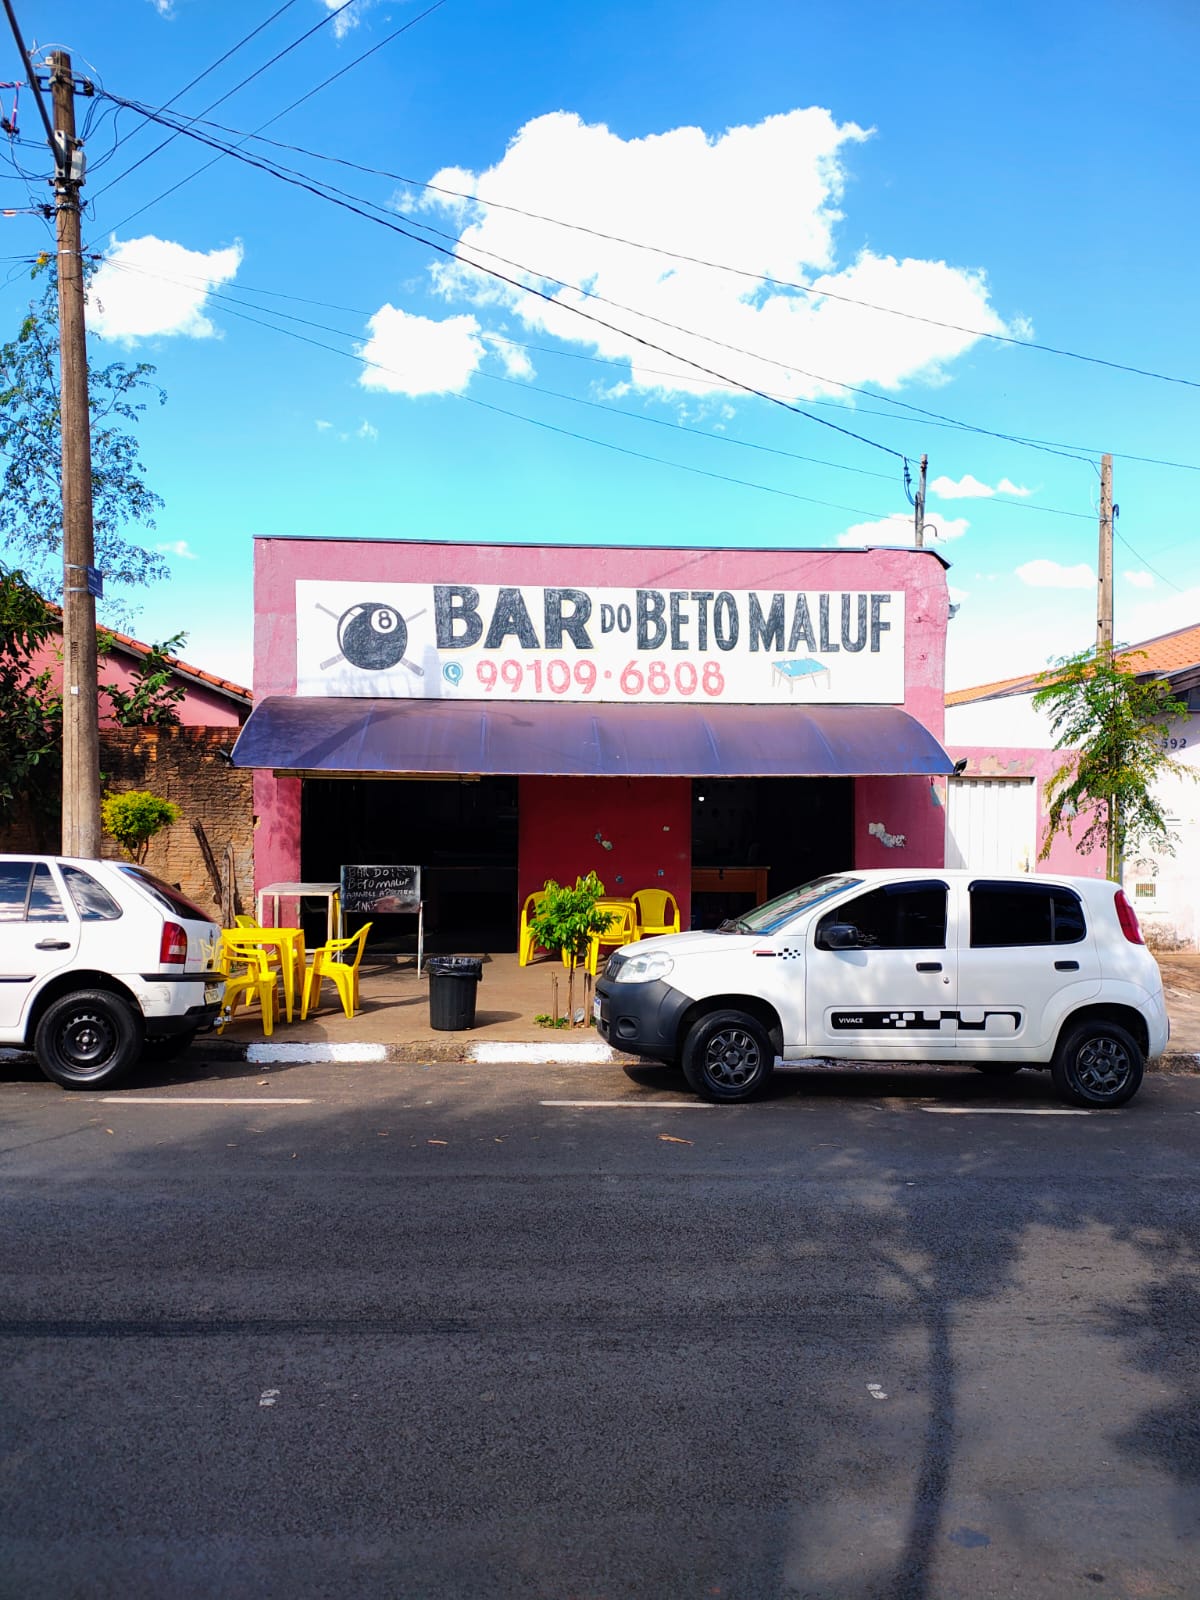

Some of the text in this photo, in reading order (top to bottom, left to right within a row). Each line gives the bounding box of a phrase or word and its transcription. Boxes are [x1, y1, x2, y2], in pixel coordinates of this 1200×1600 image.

[378, 610, 391, 629] 8
[434, 586, 891, 652] BAR DO BETO MALUF
[348, 867, 370, 878] BAR
[347, 877, 410, 890] BETO MALUF
